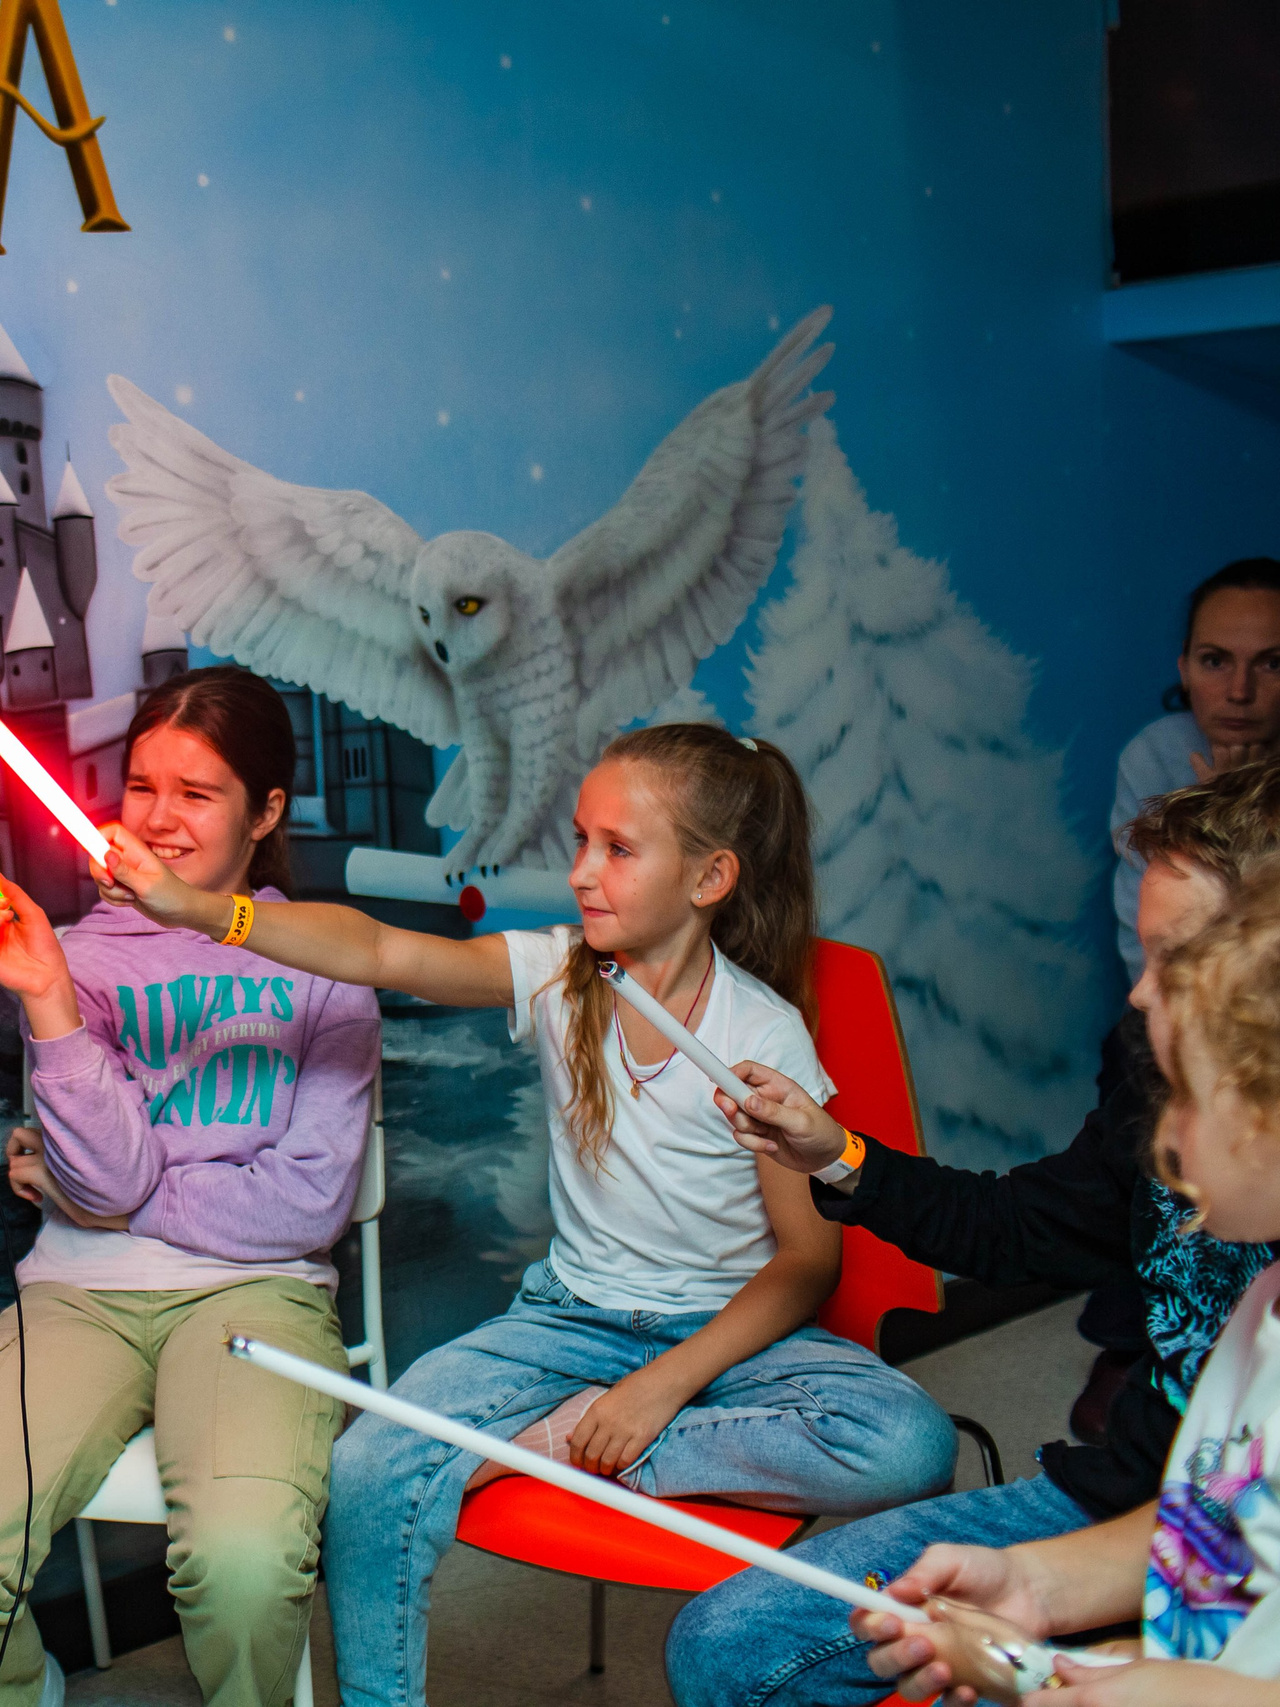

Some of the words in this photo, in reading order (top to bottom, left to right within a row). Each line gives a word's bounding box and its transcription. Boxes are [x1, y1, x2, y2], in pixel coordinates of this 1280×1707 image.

[234, 906, 247, 936] JOYA
[117, 974, 294, 1070] ALWAYS
[215, 1022, 281, 1045] EVERYDAY
[126, 1044, 296, 1128] NCIN'
